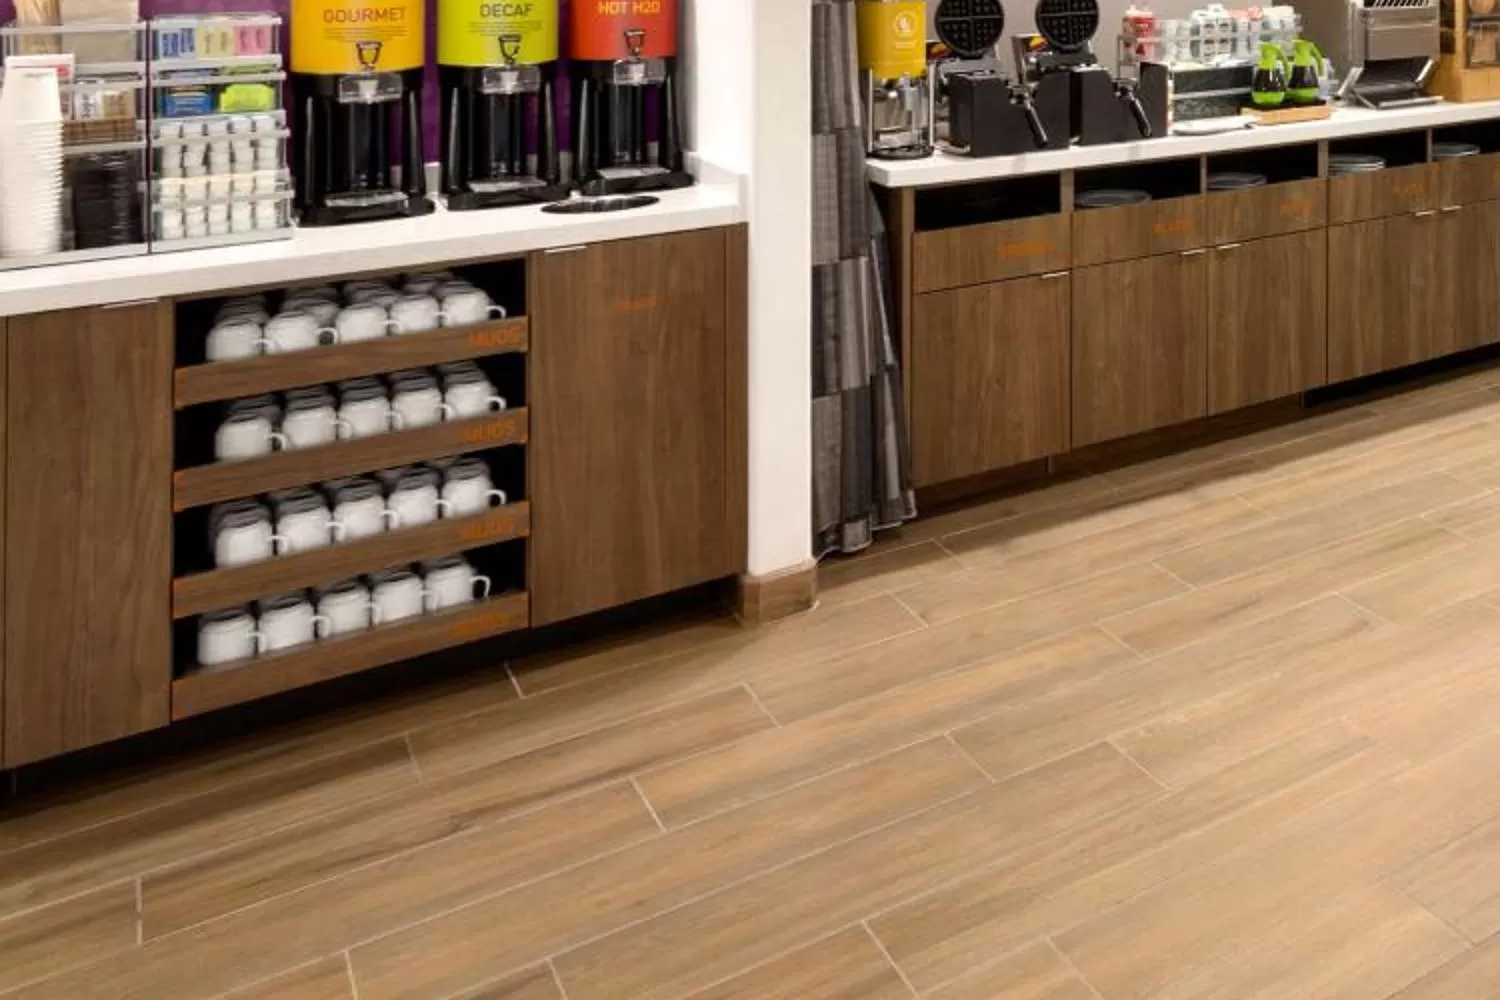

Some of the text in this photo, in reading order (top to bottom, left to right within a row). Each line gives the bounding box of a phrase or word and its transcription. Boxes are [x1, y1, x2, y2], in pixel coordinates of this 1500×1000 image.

[323, 6, 406, 23] GOURMET
[479, 3, 534, 18] DECAF
[598, 0, 627, 16] HOT
